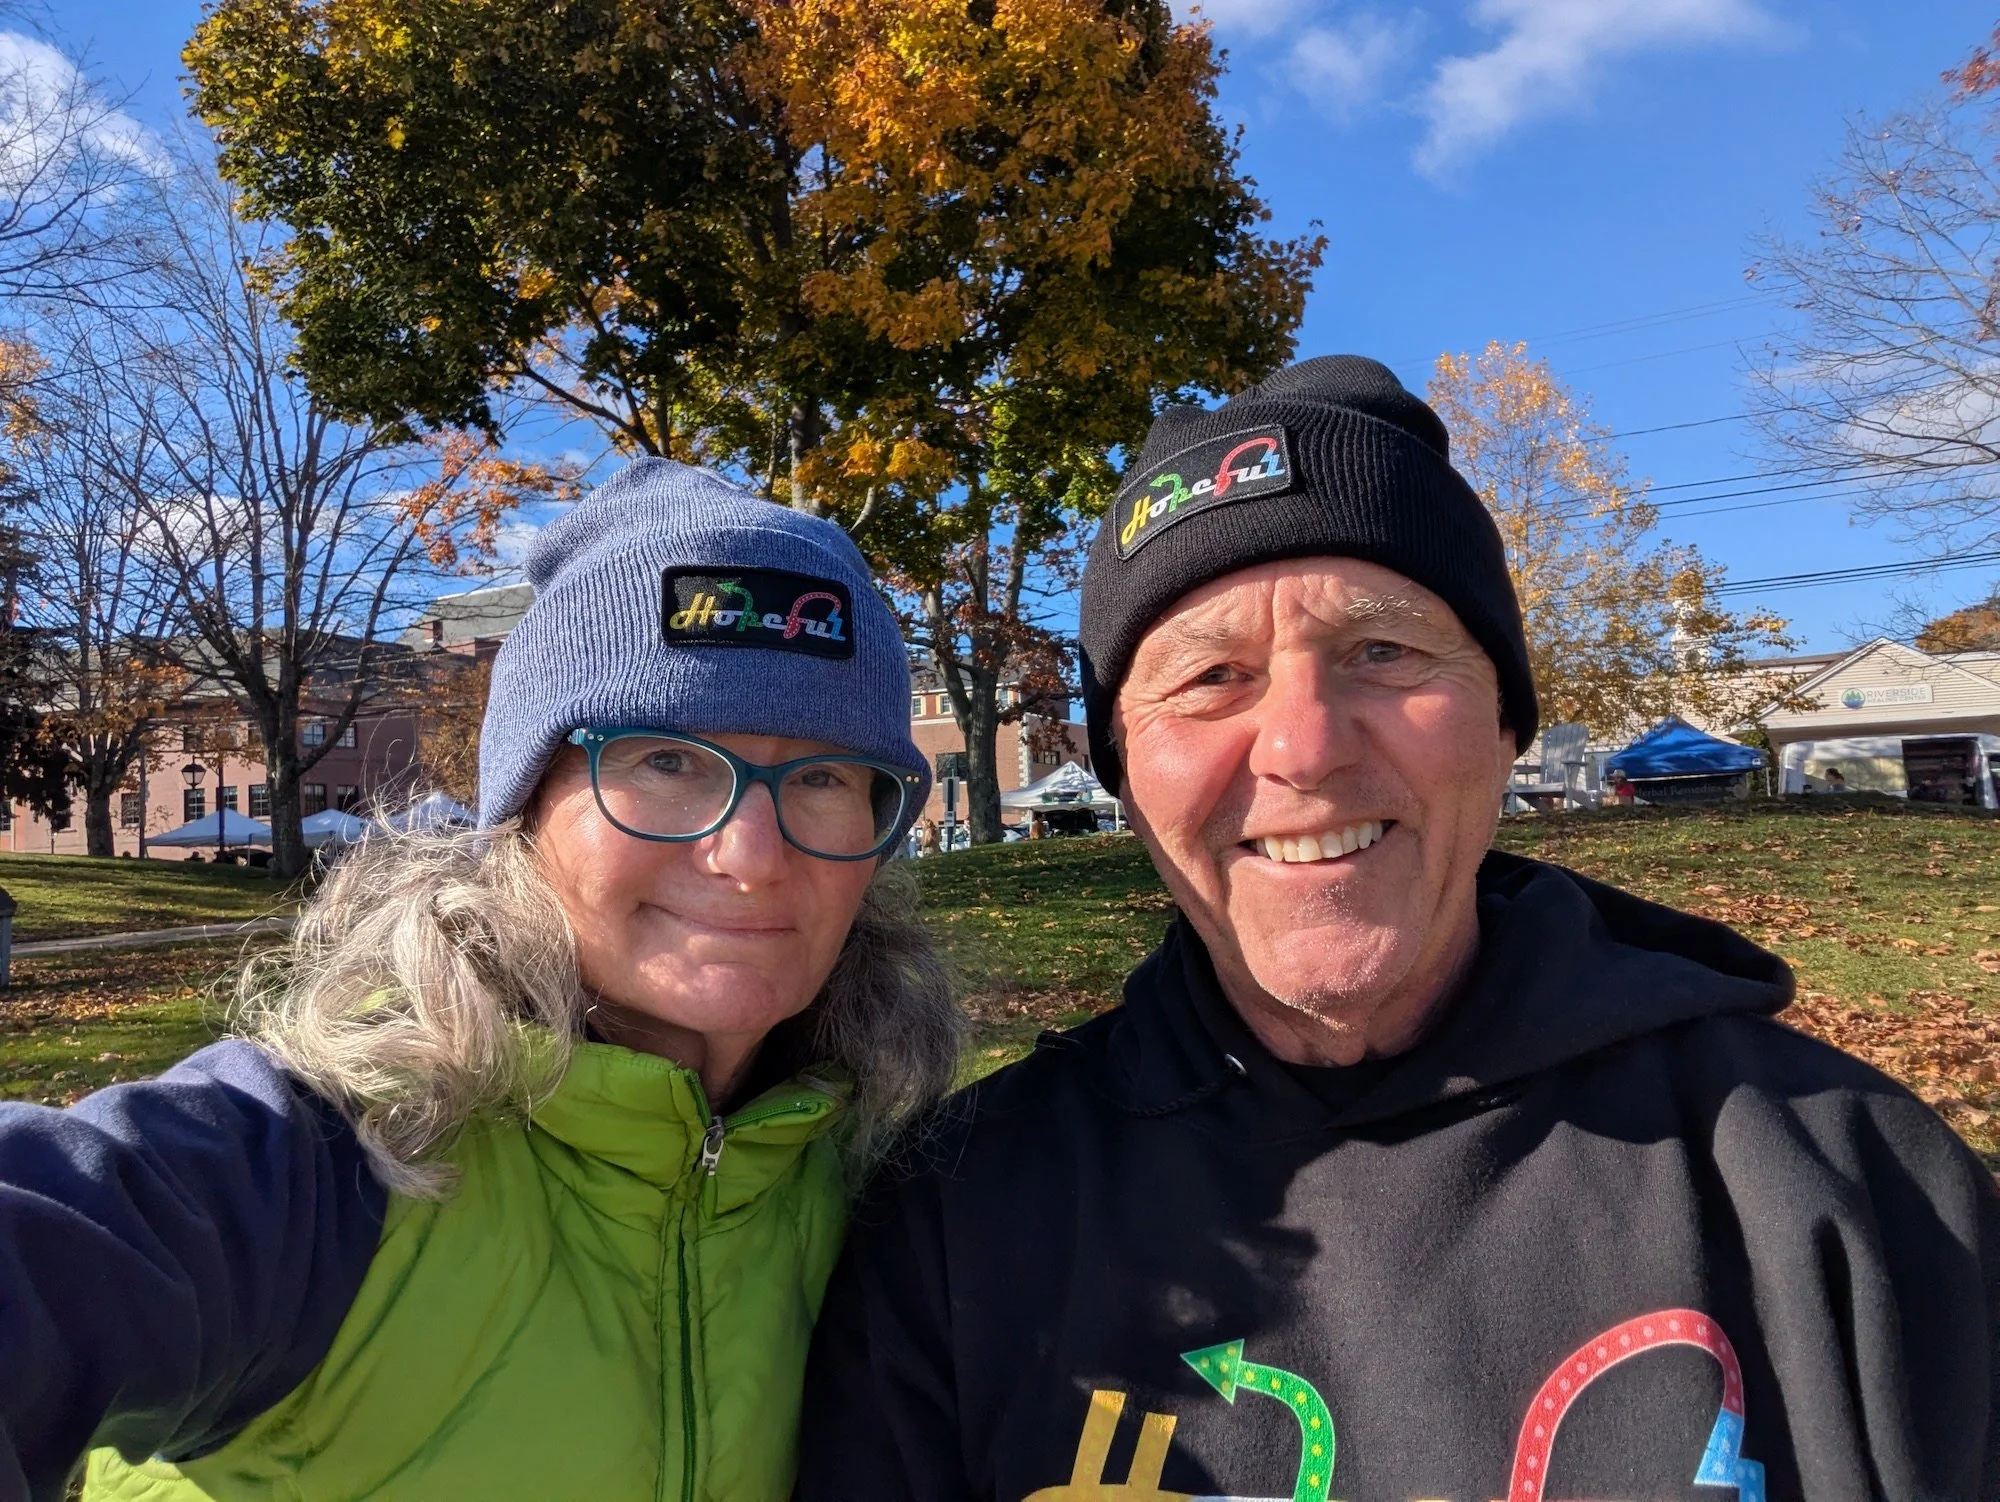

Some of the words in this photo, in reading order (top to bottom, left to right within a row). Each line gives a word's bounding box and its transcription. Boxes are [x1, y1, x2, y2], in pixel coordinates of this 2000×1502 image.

[1121, 437, 1286, 546] Hopeful
[669, 581, 846, 641] Hopeful
[1867, 687, 1926, 697] RIVERSIDE
